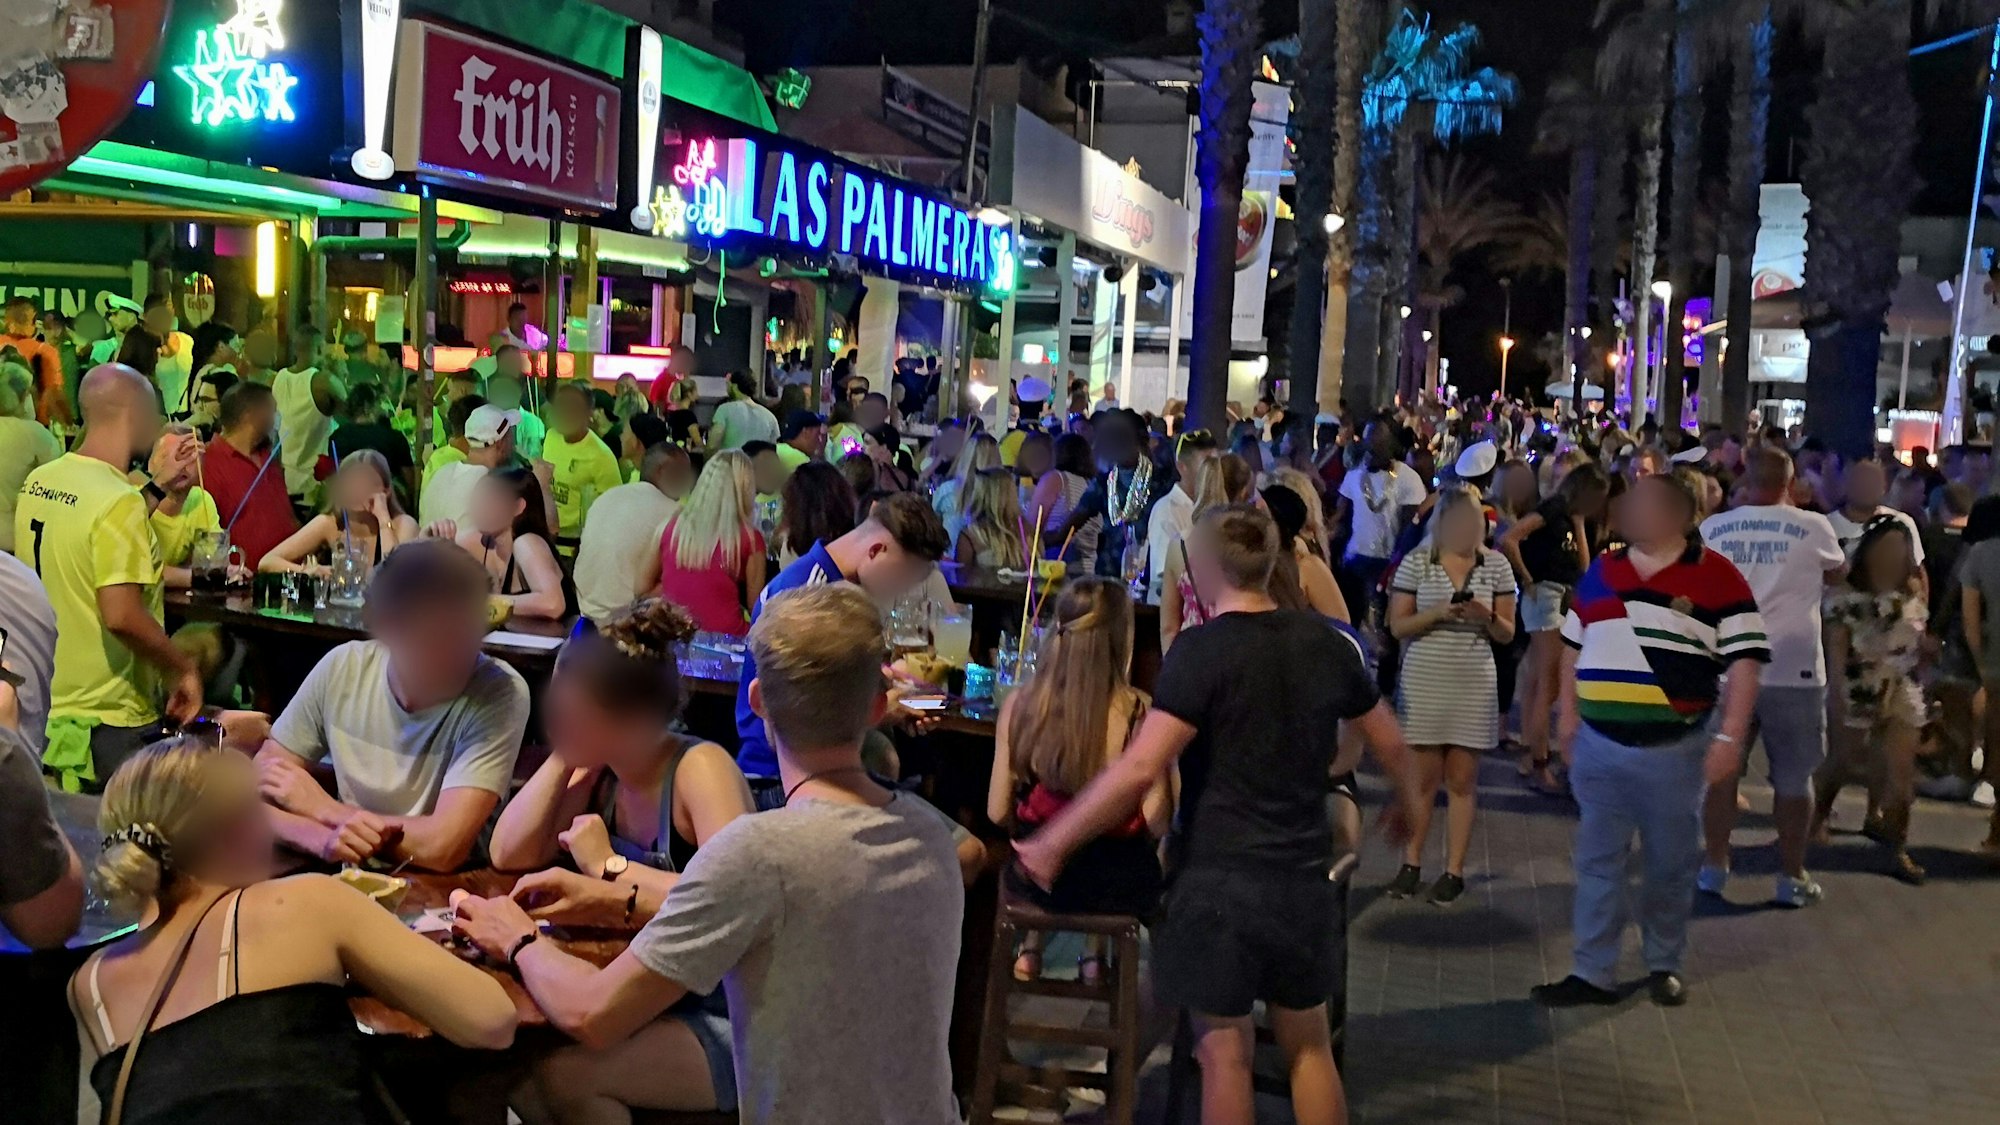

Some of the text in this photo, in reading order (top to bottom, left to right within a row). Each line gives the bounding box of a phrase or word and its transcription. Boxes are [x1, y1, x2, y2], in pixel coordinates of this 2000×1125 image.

[453, 55, 561, 184] früh
[566, 94, 577, 177] KÖLSCH
[737, 138, 1003, 283] LAS PALMERAS
